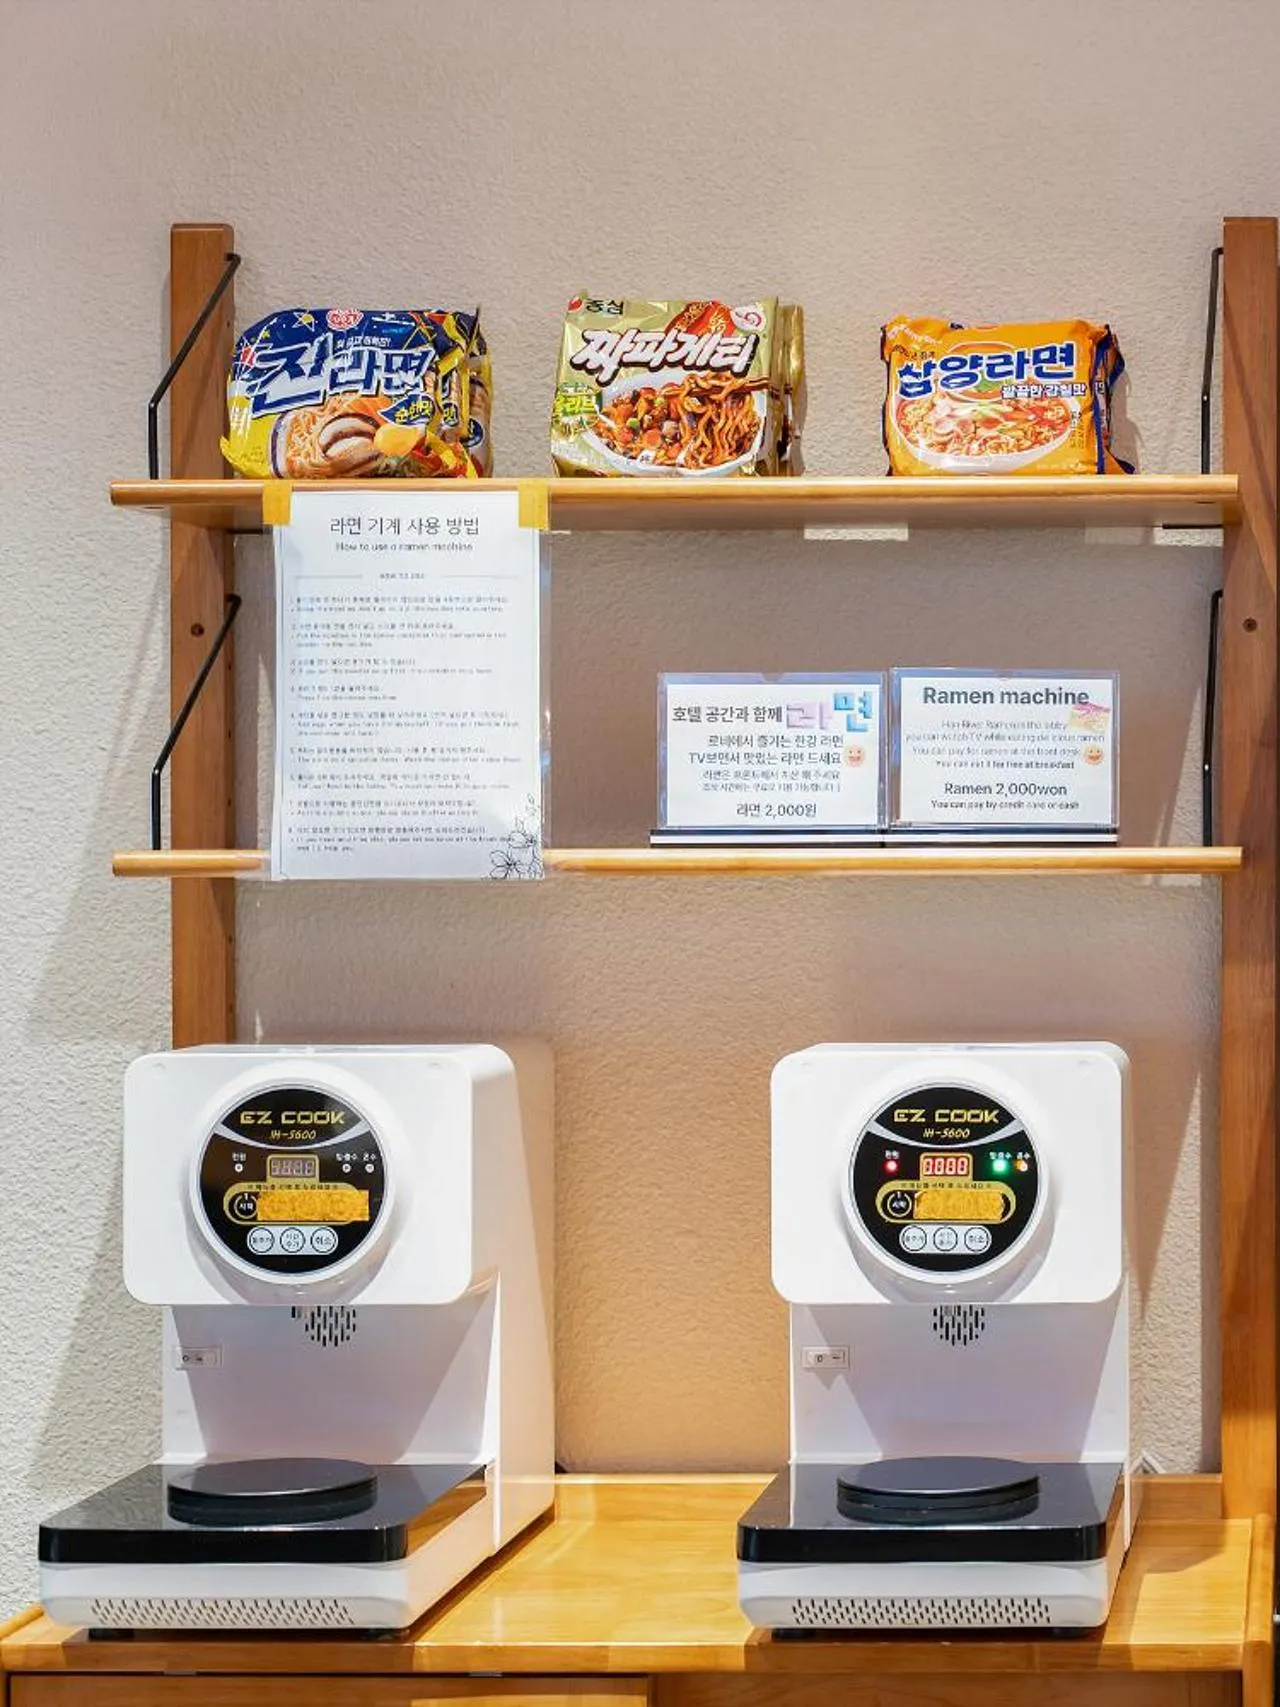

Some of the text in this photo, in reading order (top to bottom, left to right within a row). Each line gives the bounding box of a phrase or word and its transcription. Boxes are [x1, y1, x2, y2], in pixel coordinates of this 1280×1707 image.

[570, 328, 760, 386] 짜파게티
[243, 331, 438, 419] 진라면
[897, 342, 1076, 400] 삼양라면
[394, 400, 432, 424] 순한맛
[331, 517, 479, 537] 라면 기계 사용 방법
[923, 687, 1090, 704] Ramen machine
[672, 706, 702, 723] 호텔
[705, 706, 749, 723] 공간과
[753, 706, 782, 723] 함께
[757, 735, 791, 748] 즐기는
[689, 751, 740, 765] TV보면서
[781, 751, 805, 765] 라면
[808, 751, 841, 765] 드세요
[944, 782, 1068, 797] Ramen 2,000won
[736, 803, 817, 819] 라면 2,000원
[240, 1110, 346, 1125] EZ COOK
[893, 1109, 999, 1124] EZ COOK
